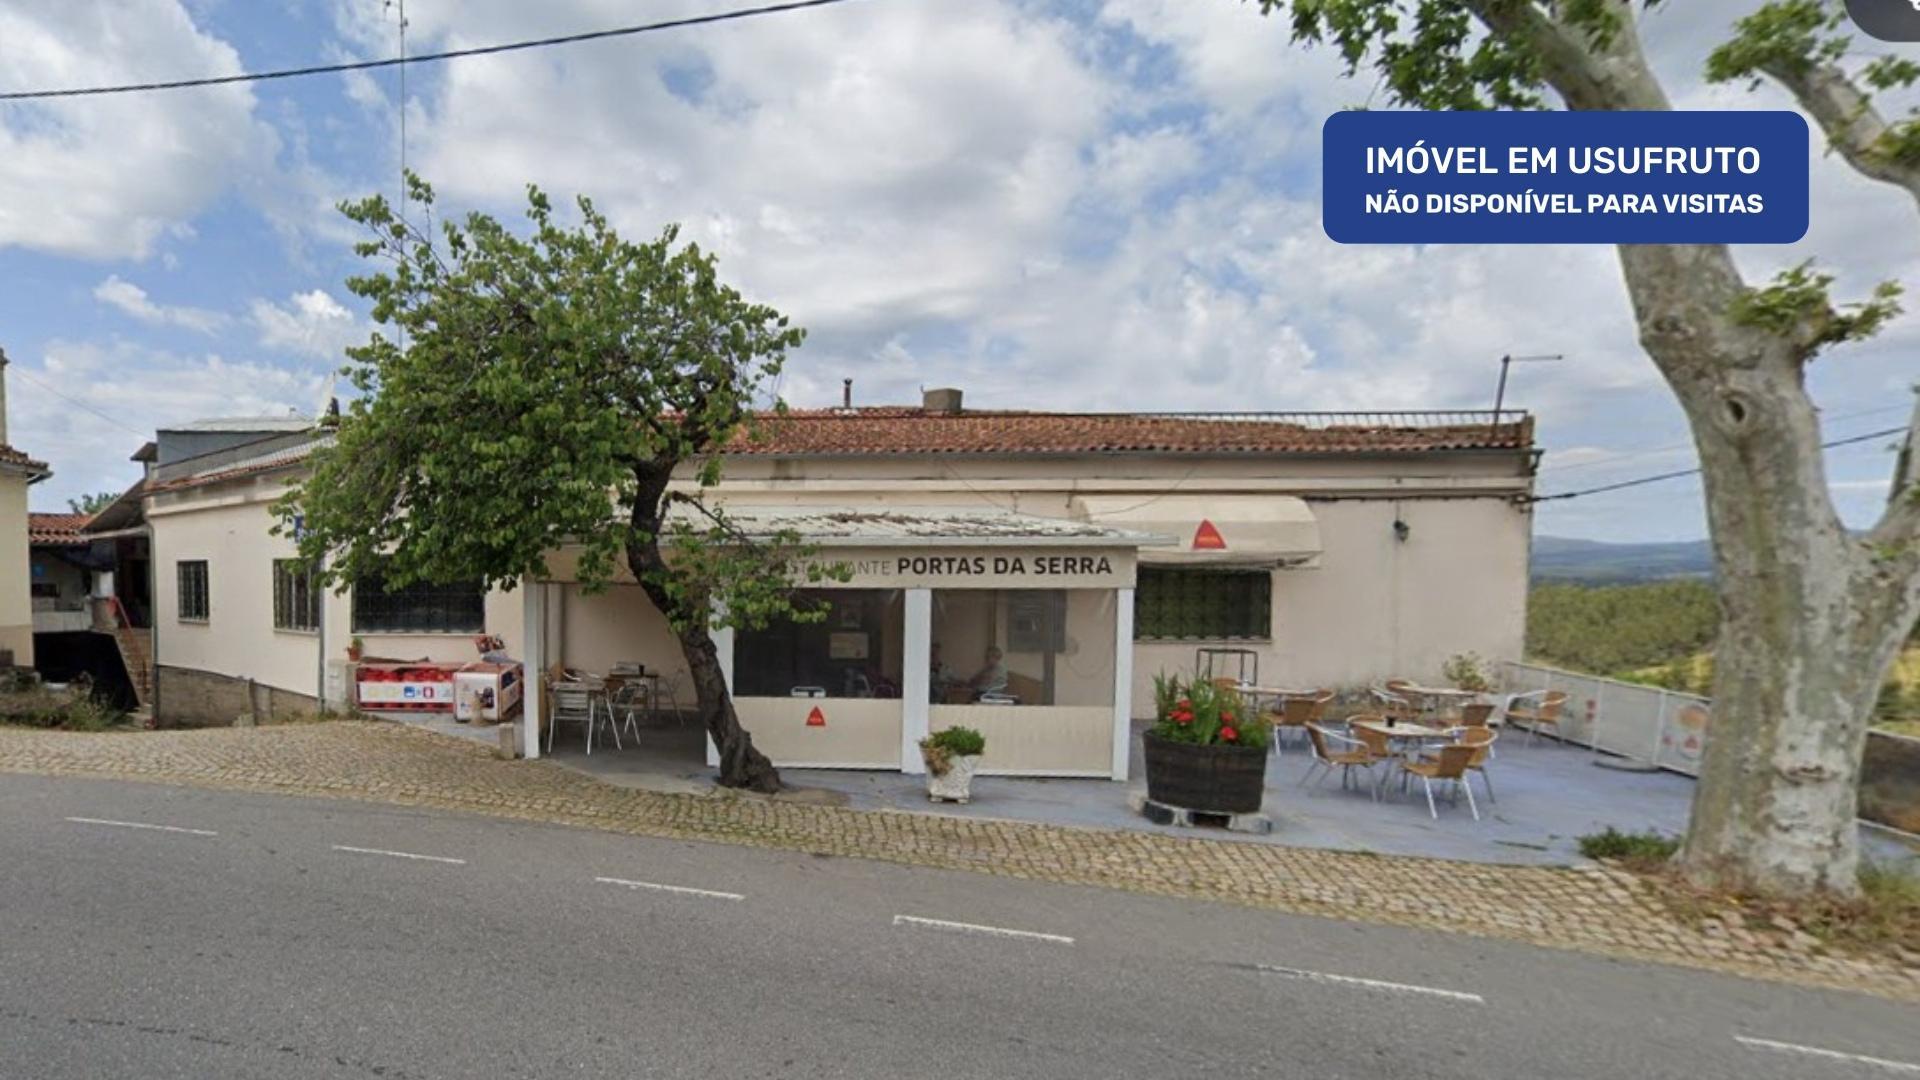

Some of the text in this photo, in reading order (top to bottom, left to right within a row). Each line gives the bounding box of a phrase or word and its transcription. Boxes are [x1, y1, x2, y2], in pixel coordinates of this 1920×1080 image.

[897, 556, 985, 575] PORTAS
[993, 557, 1026, 575] DA
[1034, 556, 1112, 575] SERRA
